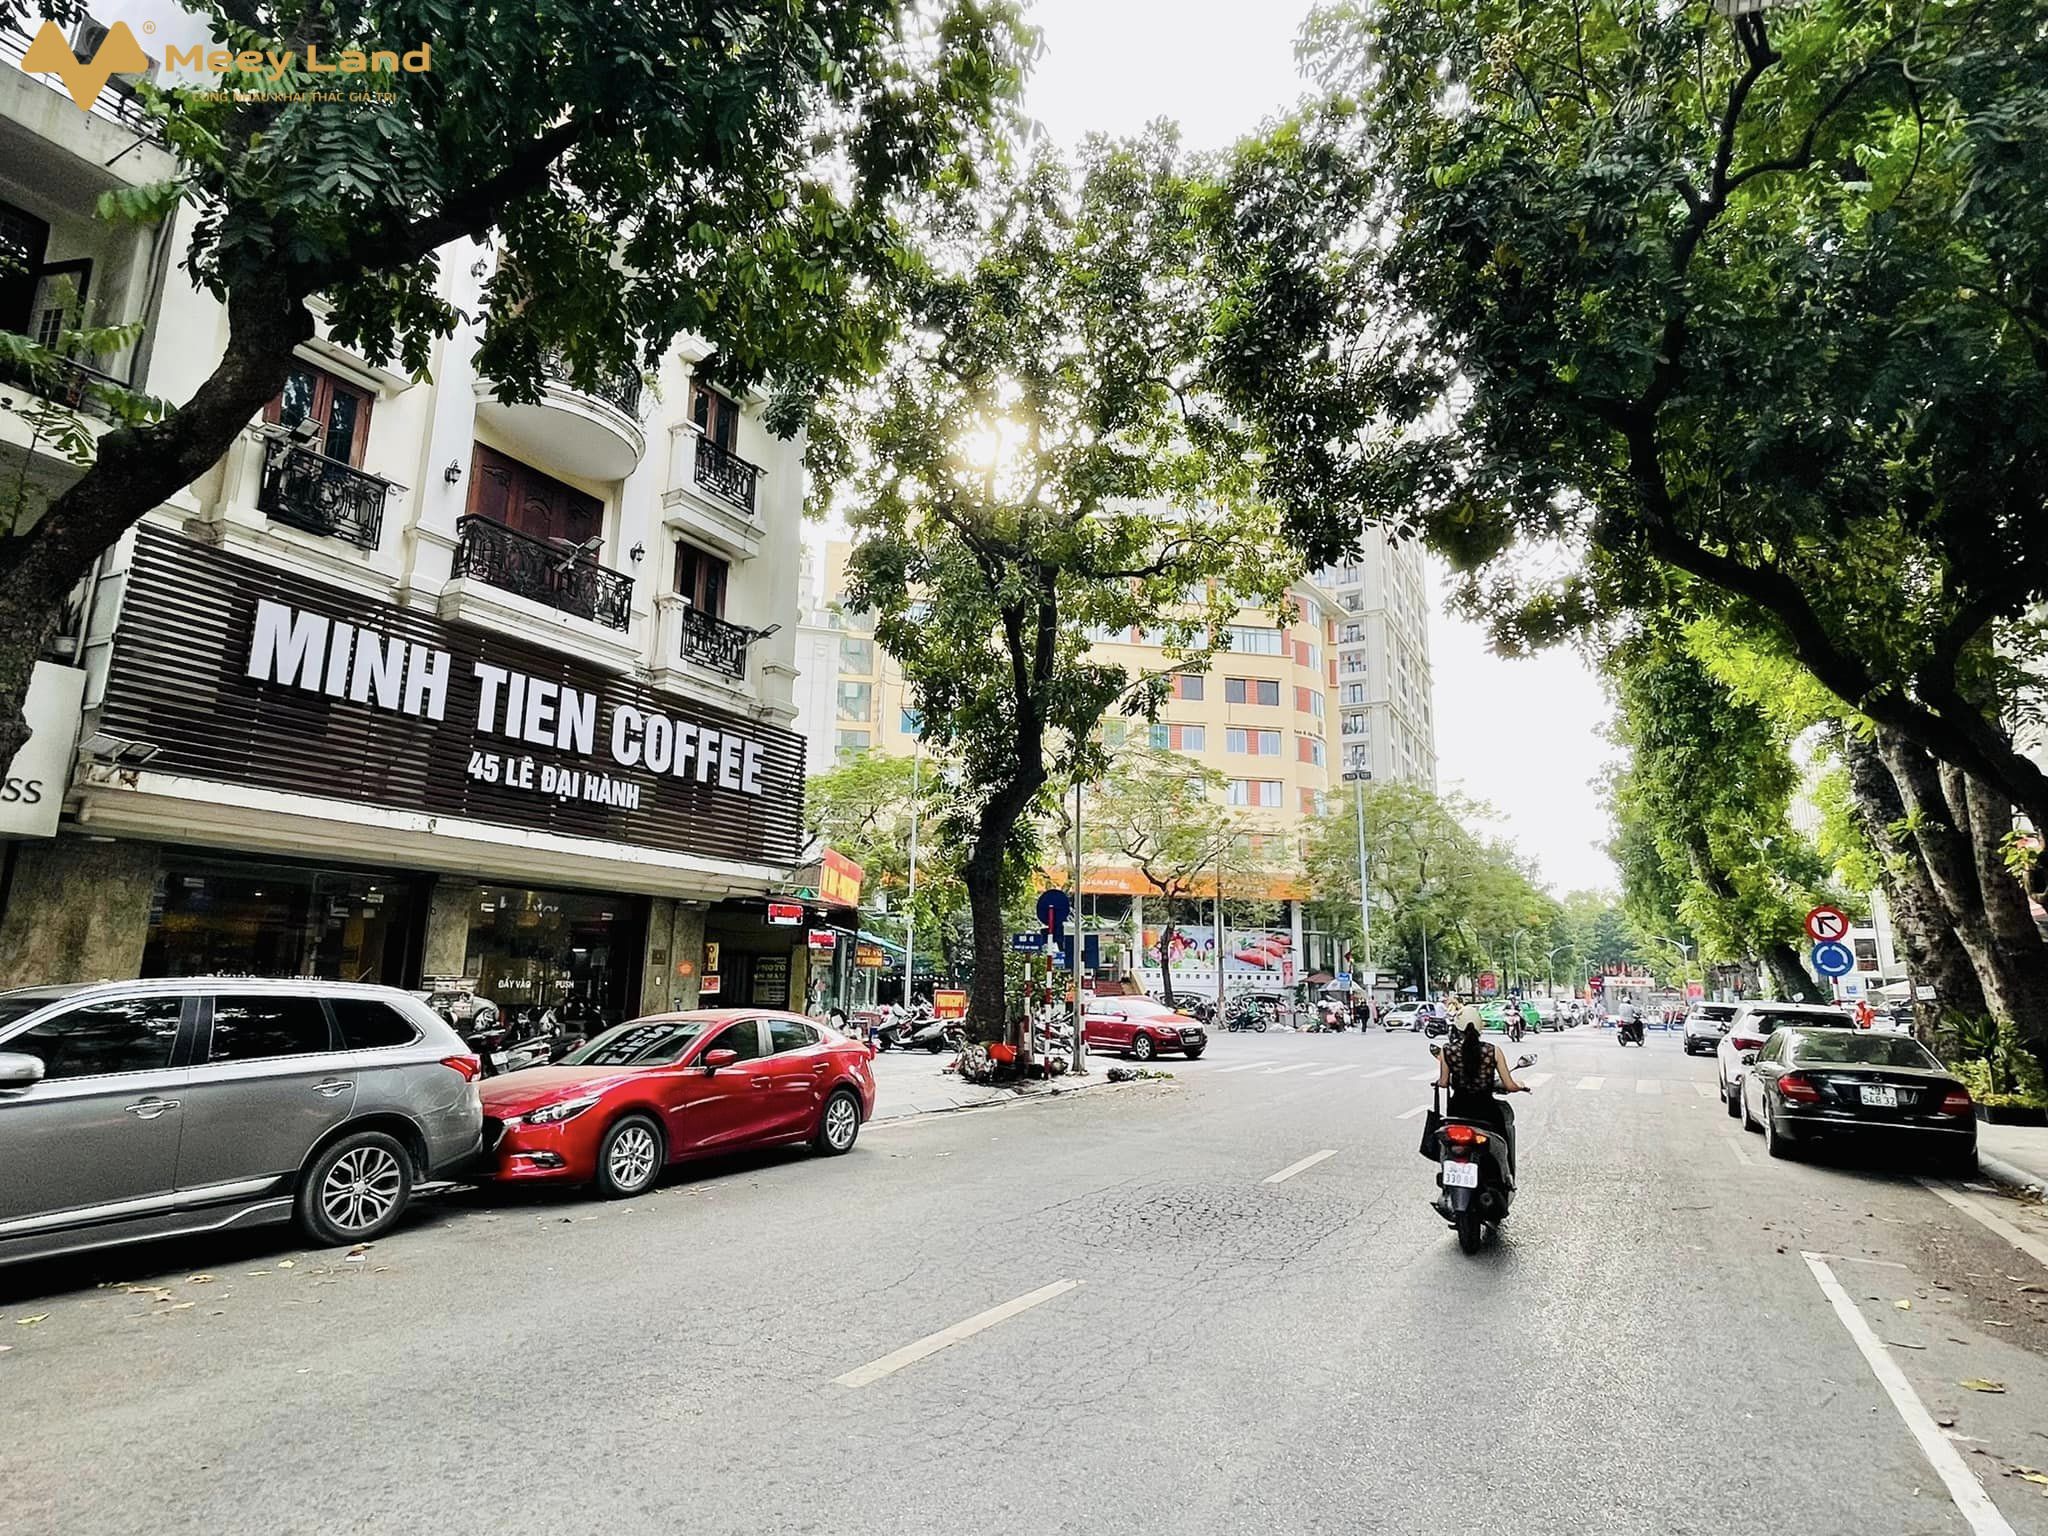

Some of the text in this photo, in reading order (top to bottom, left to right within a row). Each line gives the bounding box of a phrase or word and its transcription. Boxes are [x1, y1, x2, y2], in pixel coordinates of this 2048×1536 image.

[246, 599, 765, 795] MINH TIEN COFFEE
[467, 750, 640, 810] 45 LÊ ĐẠI HÀNH
[555, 980, 575, 989] PUSH
